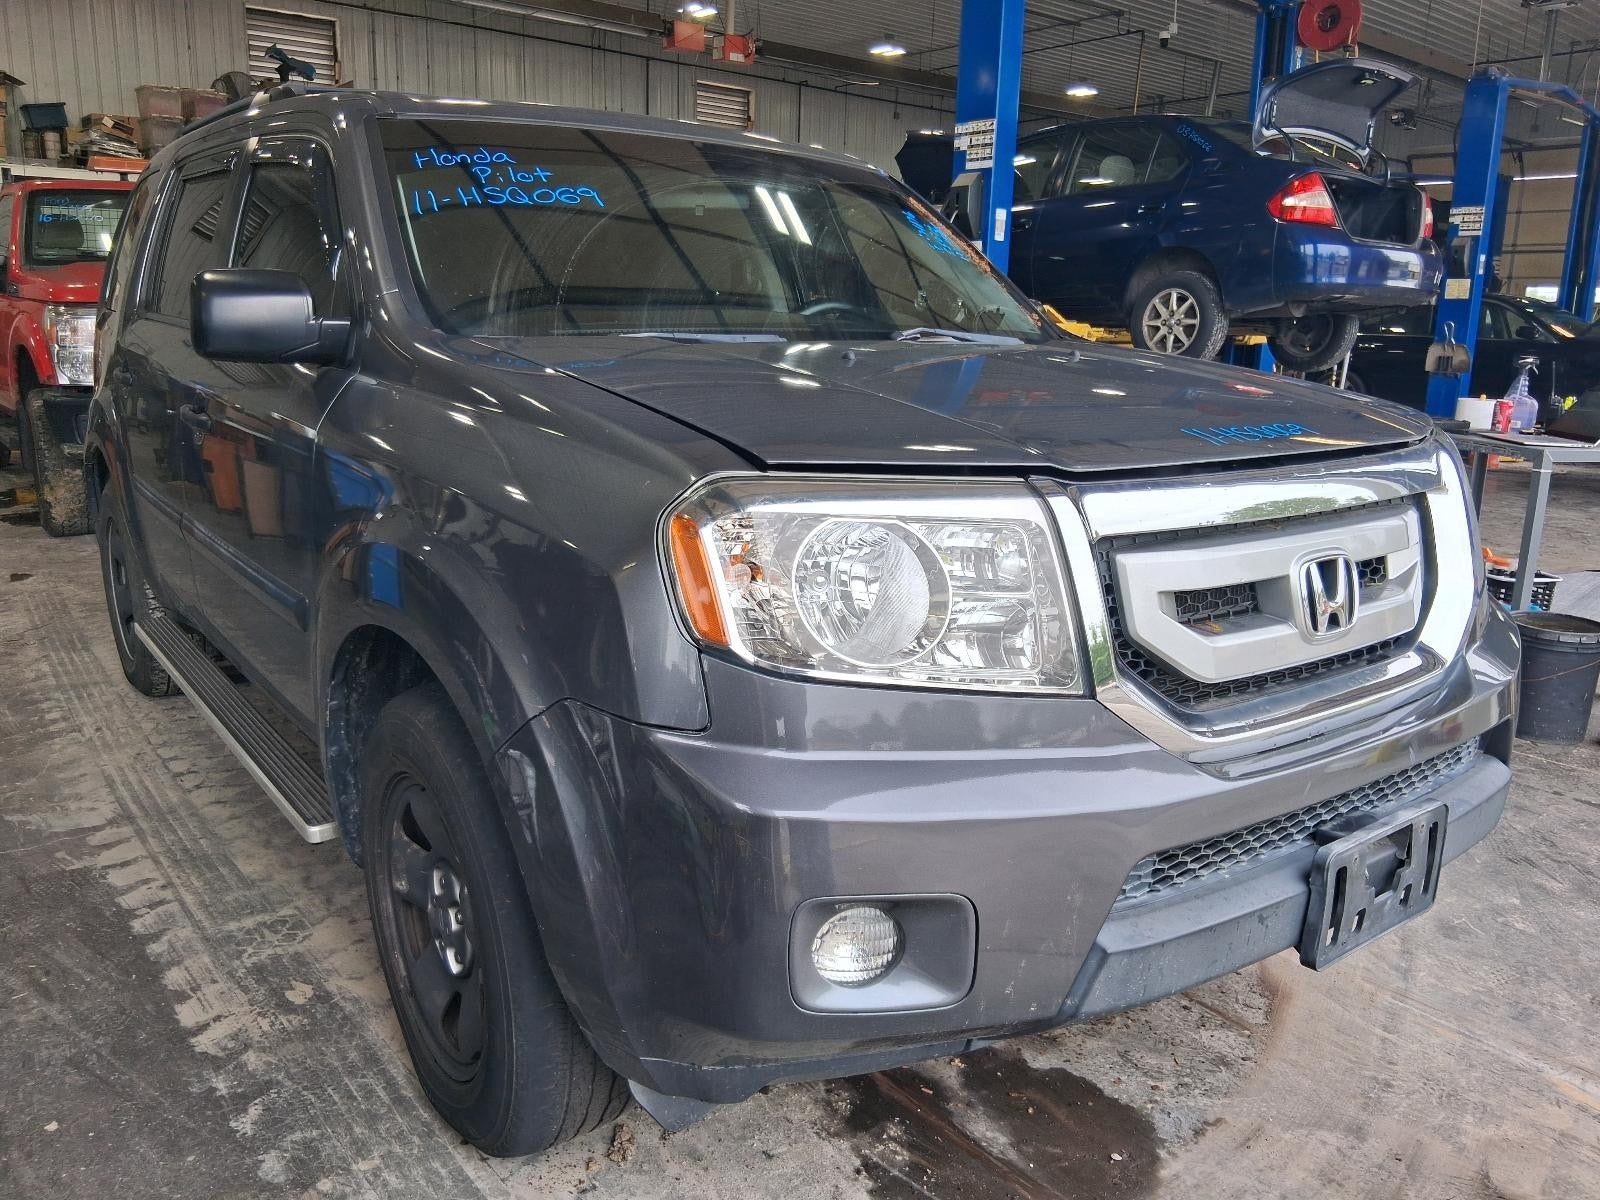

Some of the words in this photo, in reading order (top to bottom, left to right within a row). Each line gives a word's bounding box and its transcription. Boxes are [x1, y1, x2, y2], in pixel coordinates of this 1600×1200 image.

[414, 147, 517, 169] Honda
[472, 166, 554, 184] Pilot
[414, 186, 606, 215] 11-HSQ069
